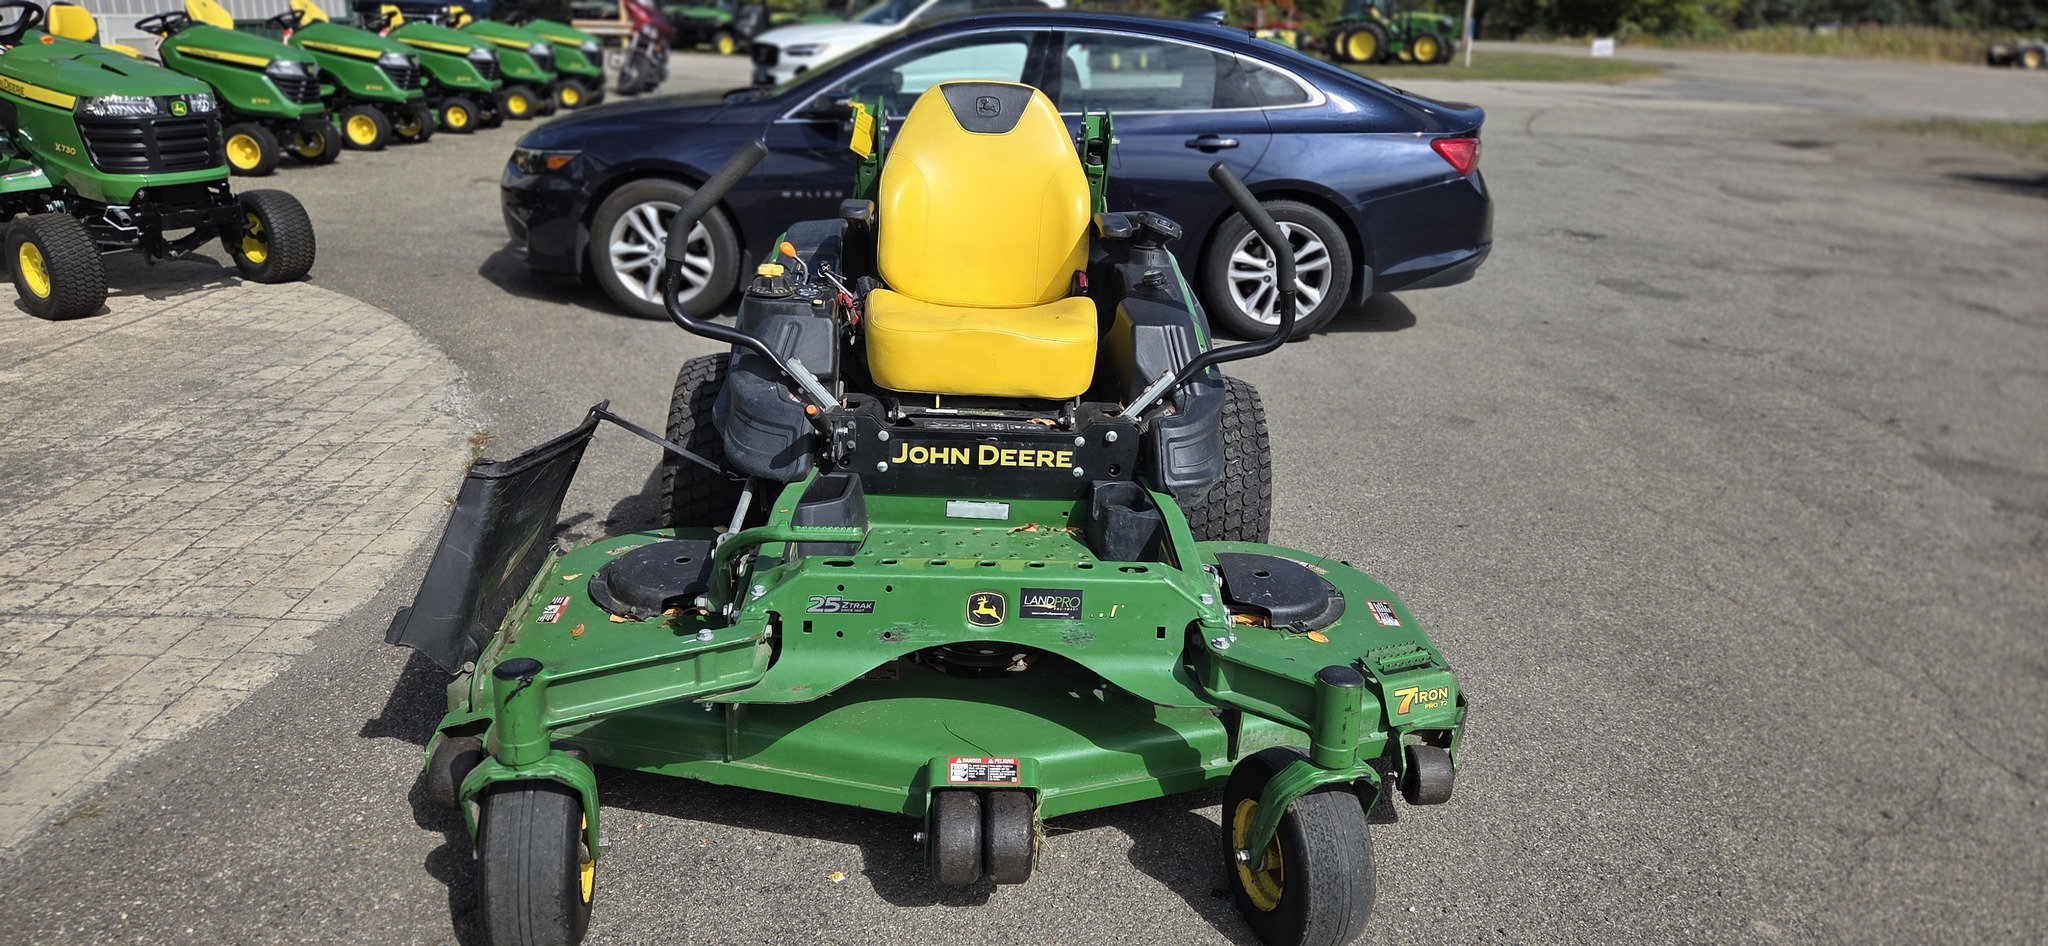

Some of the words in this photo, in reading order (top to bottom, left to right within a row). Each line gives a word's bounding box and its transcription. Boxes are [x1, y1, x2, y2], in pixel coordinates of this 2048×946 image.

[55, 142, 77, 155] X730
[892, 442, 970, 465] JOHN
[978, 444, 1073, 468] DEERE
[807, 596, 841, 613] 25
[841, 601, 872, 609] ZTRAK
[1023, 595, 1081, 609] LANDPRO
[1424, 702, 1438, 710] PRO
